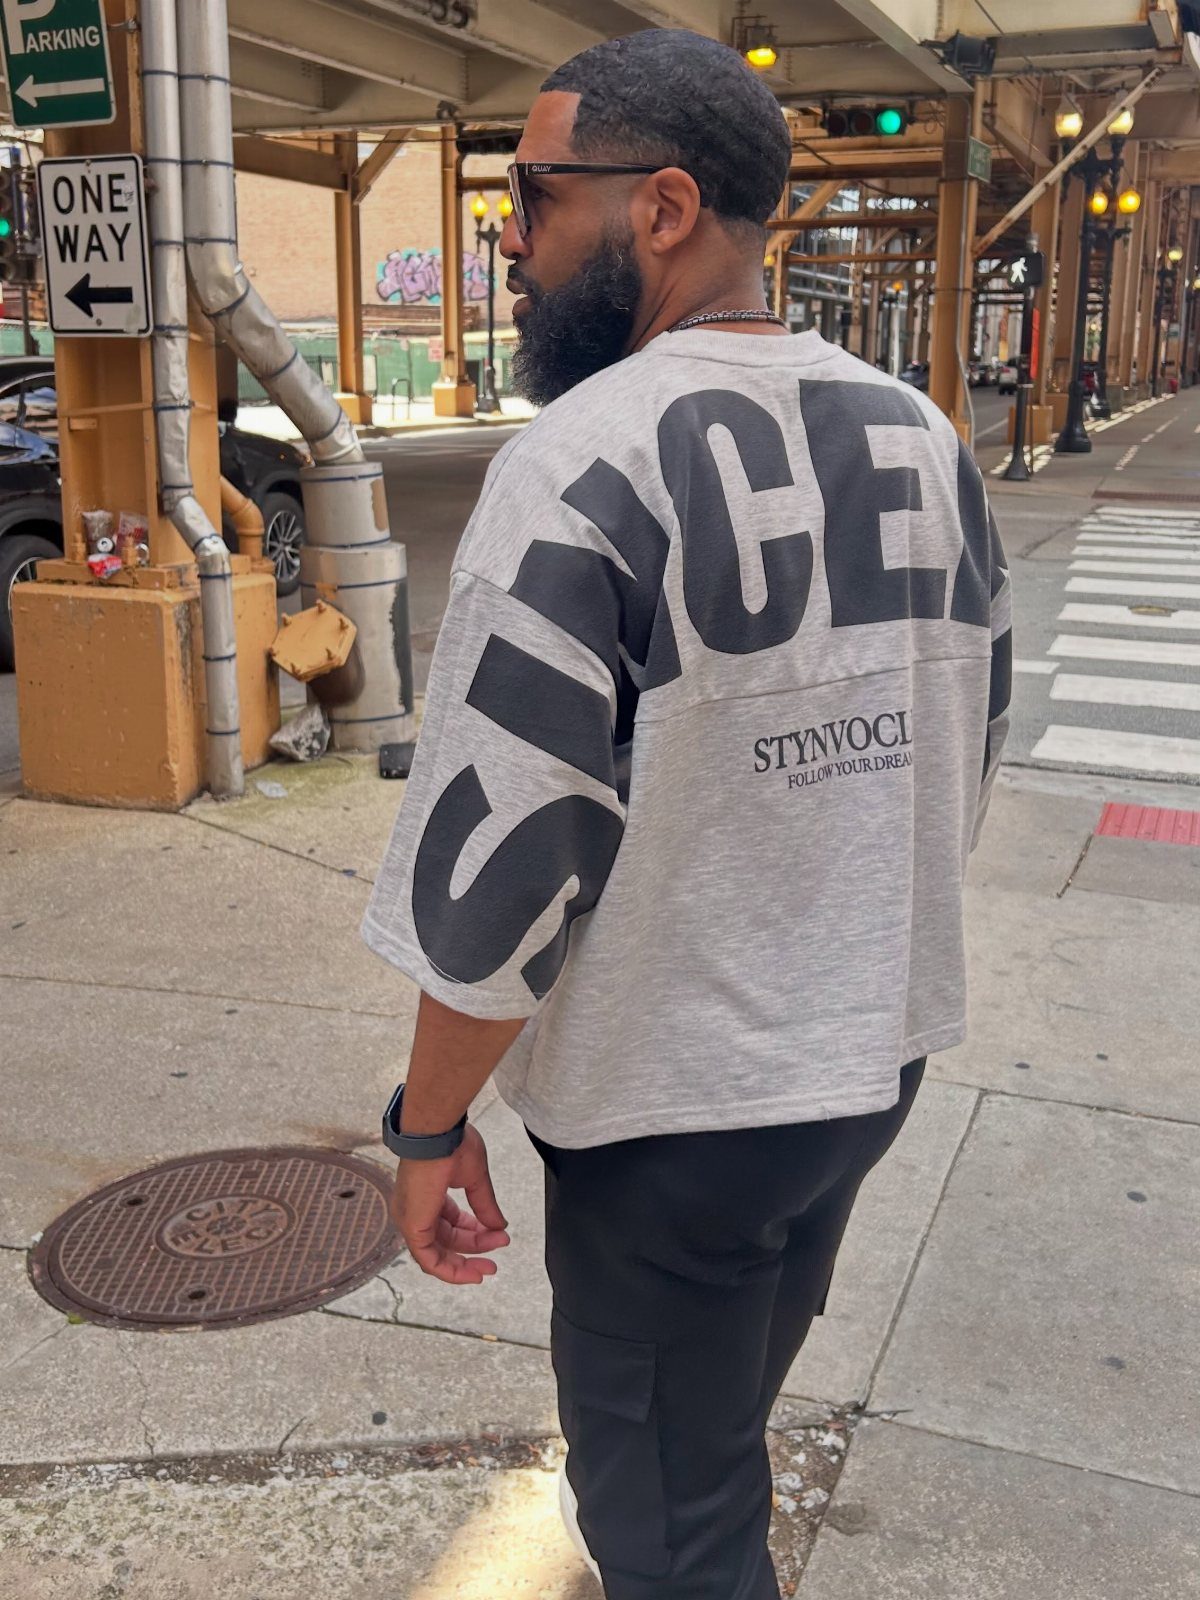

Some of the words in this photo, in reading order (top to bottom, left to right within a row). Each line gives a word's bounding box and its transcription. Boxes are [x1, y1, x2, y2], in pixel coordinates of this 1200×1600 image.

[53, 173, 128, 215] ONE
[53, 222, 131, 263] WAY
[754, 709, 912, 773] STYNVOCL
[788, 763, 834, 789] FOLLOW
[834, 758, 873, 776] YOUR
[186, 1199, 281, 1221] CITY
